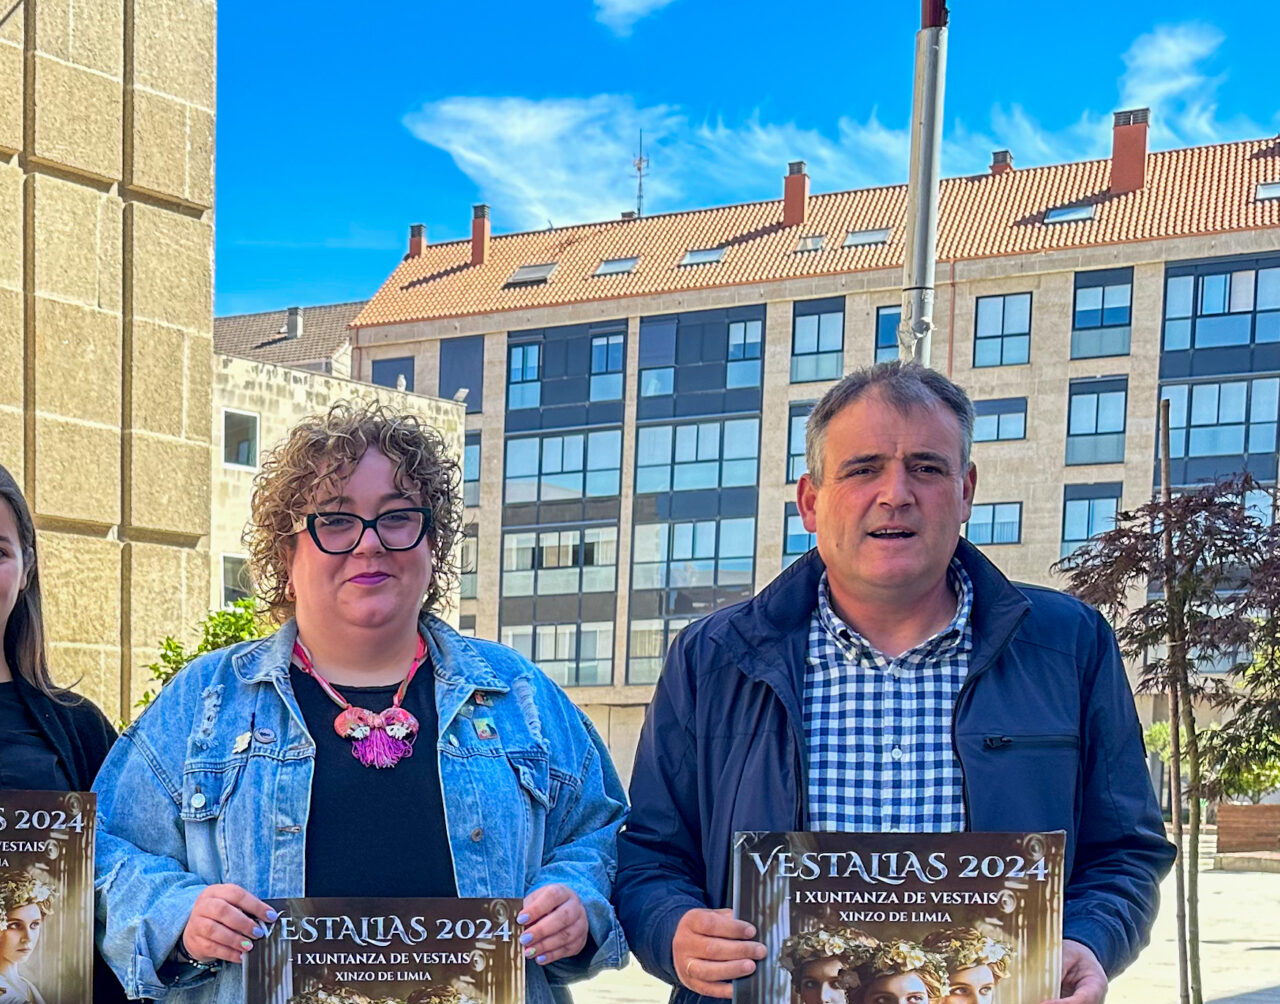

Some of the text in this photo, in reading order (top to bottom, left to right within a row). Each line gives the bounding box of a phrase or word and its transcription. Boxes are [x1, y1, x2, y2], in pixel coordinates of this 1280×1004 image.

[14, 809, 84, 832] 2024
[748, 844, 1049, 885] VESTALIAS 2024
[795, 891, 997, 904] I XUNTANZA DE VESTAIS
[839, 911, 952, 922] XINZO DE LIMIA
[436, 917, 513, 942] 2024
[297, 952, 469, 964] I XUNTANZA DE VESTAIS
[335, 971, 431, 980] XINZO DE LIMIA
